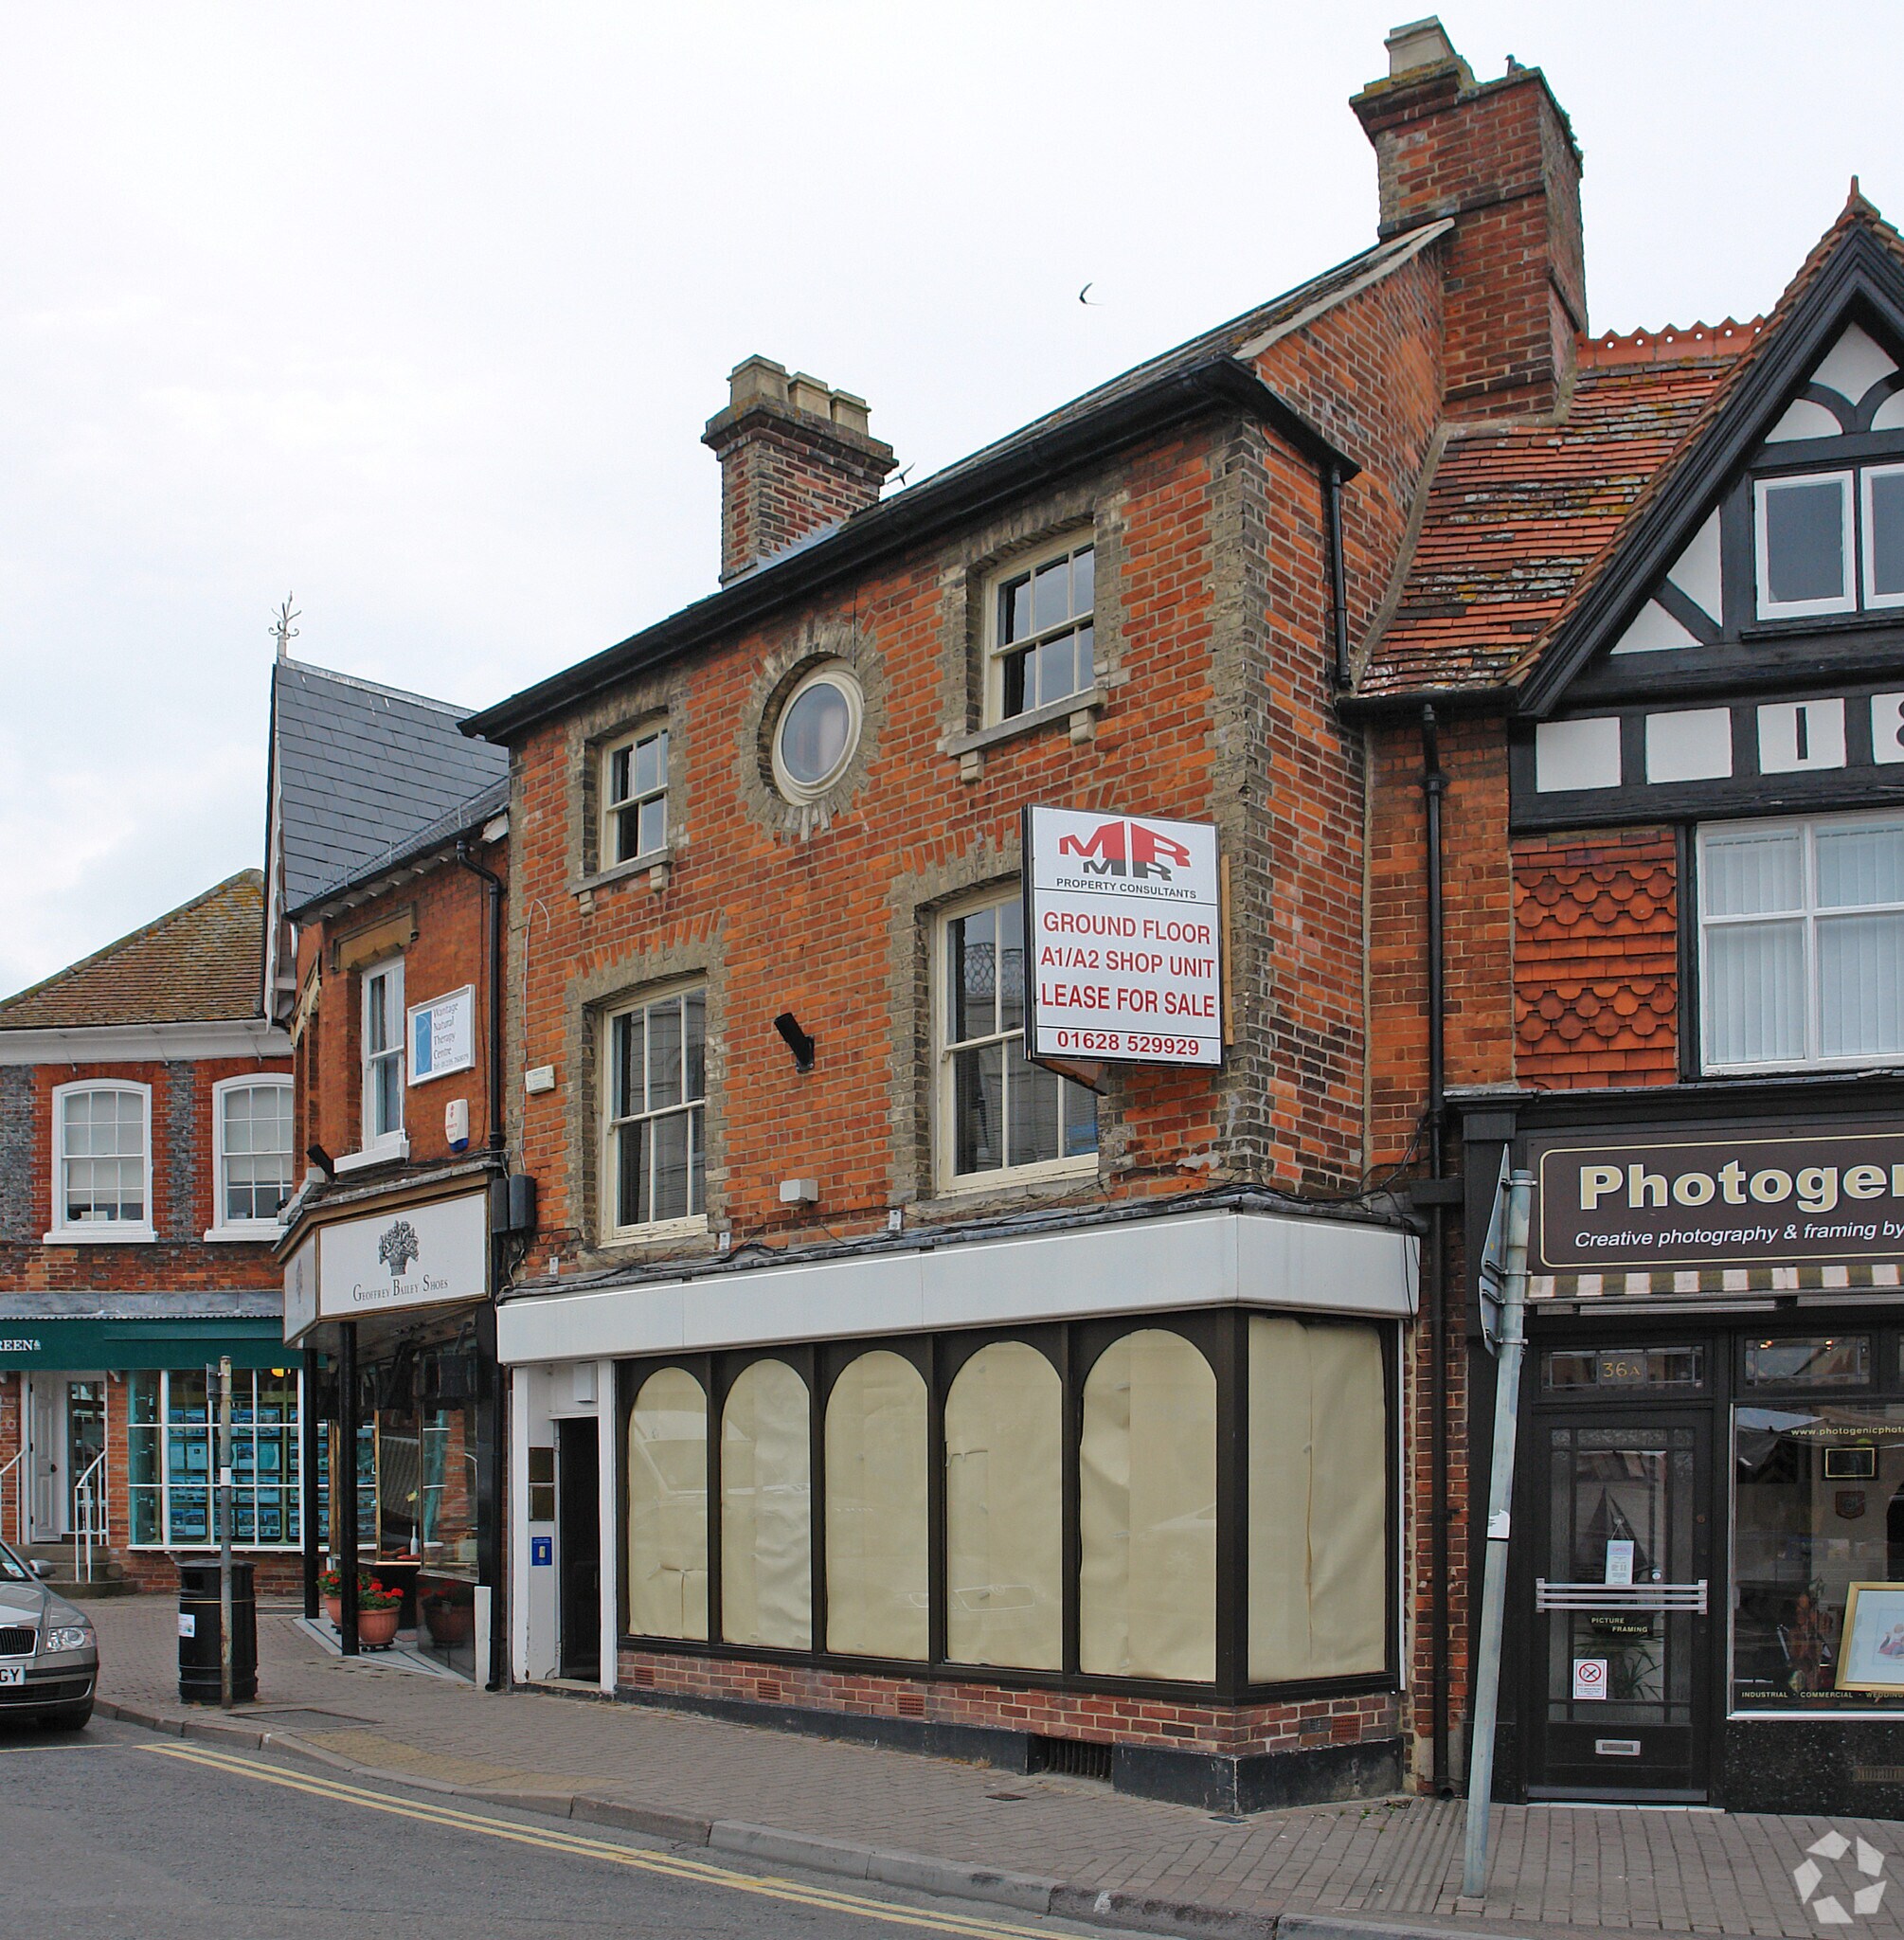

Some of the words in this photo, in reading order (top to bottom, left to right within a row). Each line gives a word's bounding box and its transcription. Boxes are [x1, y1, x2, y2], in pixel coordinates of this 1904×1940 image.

[1056, 877, 1117, 891] PROPERTY
[1119, 883, 1197, 899] CONSULTANTS
[1043, 911, 1137, 937] GROUND
[1143, 920, 1211, 945] FLOOR
[1040, 946, 1100, 969] A1/A2
[1105, 950, 1163, 974] SHOP
[1169, 957, 1214, 979] UNIT
[1041, 983, 1110, 1010] LEASE
[1117, 988, 1158, 1013] FOR
[1164, 992, 1215, 1017] SALE
[434, 1032, 456, 1046] Therapy
[1057, 1031, 1120, 1051] 01628
[1127, 1035, 1200, 1056] 529929
[434, 1048, 452, 1060] Centre
[1574, 1230, 1653, 1248] Creative
[1658, 1226, 1778, 1248] photography
[1783, 1224, 1798, 1240] &
[1803, 1222, 1876, 1241] framing
[1881, 1220, 1904, 1239] by
